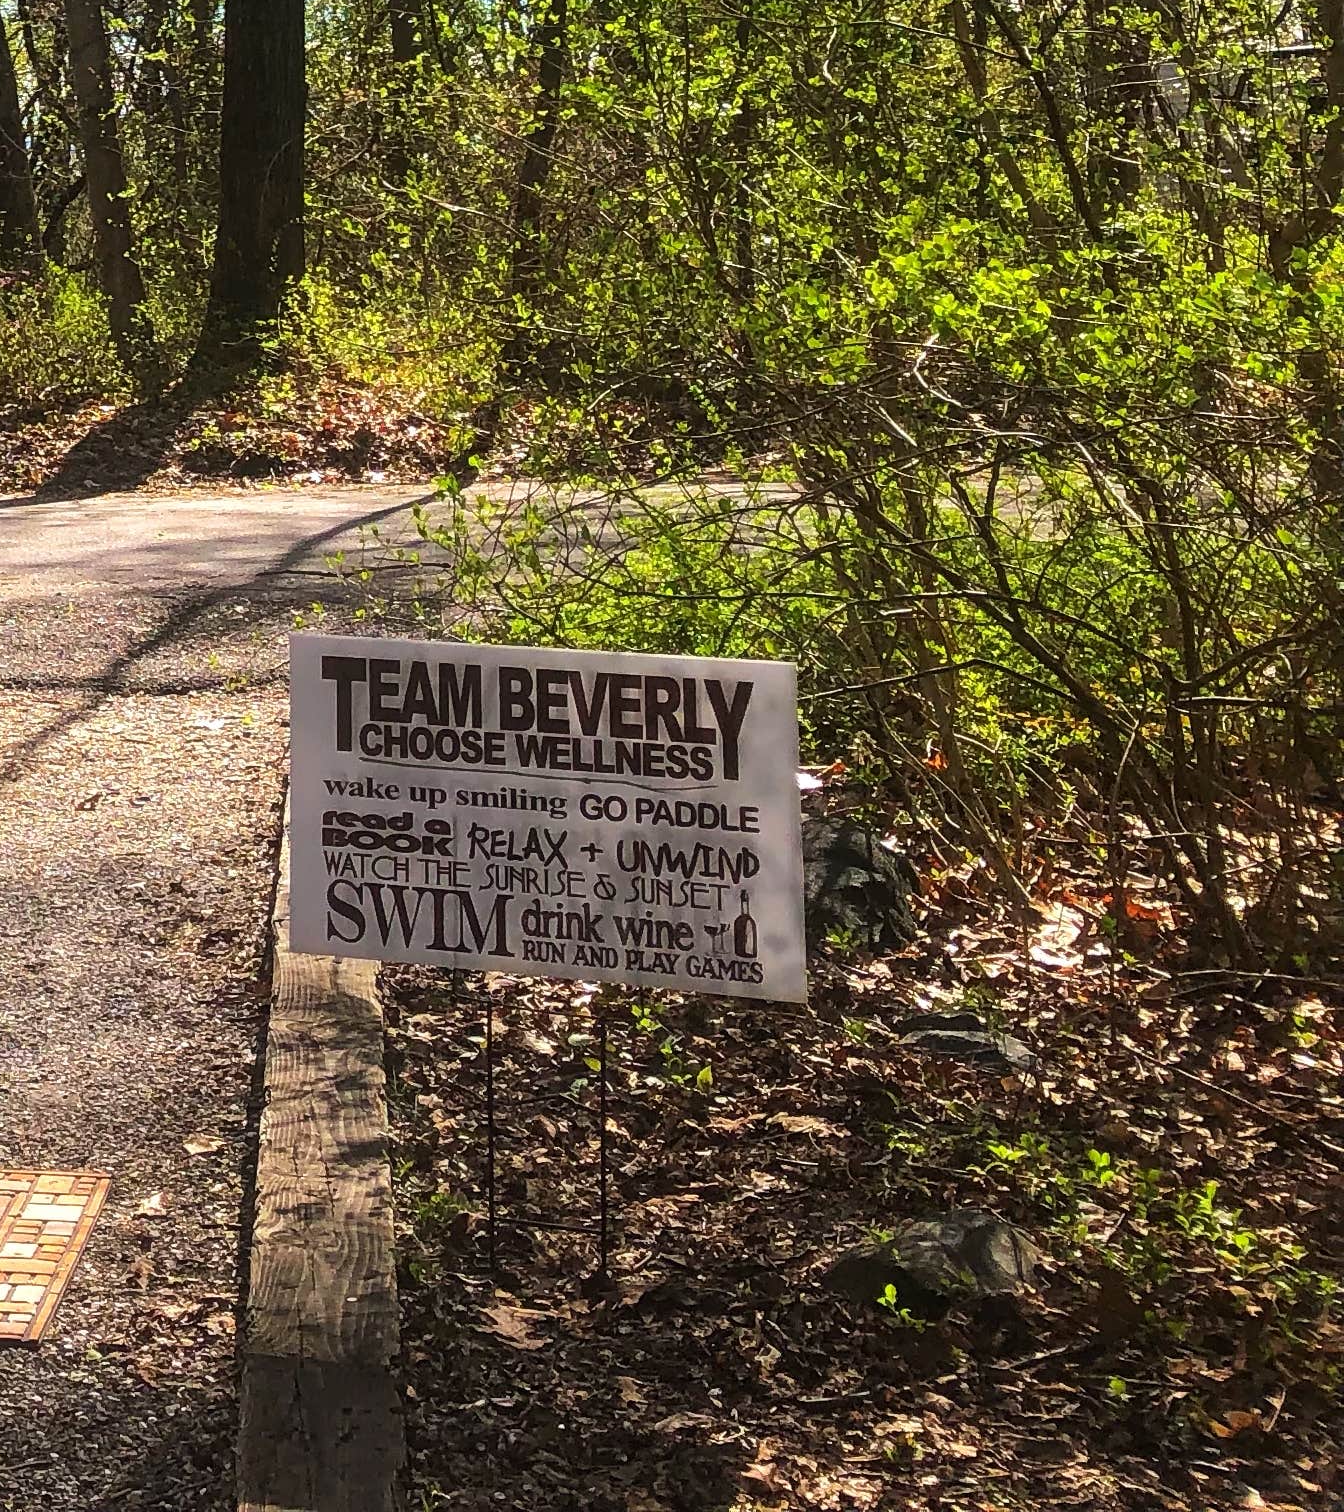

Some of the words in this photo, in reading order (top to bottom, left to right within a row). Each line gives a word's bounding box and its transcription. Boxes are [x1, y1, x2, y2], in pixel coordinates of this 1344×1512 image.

[322, 656, 482, 751] TEAM
[499, 666, 754, 781] BEVERLY
[359, 723, 506, 765] CHOOSE
[515, 734, 714, 781] WELLNESS
[322, 811, 413, 831] read
[424, 819, 452, 835] a
[323, 777, 400, 800] wake
[409, 786, 447, 809] up
[455, 787, 567, 819] smiling
[579, 793, 628, 821] GO
[635, 798, 761, 833] PADDLE
[322, 828, 454, 856] BOOK
[467, 822, 568, 869] RELAX
[580, 843, 603, 862] +
[616, 839, 760, 884] UNWIND
[323, 850, 409, 882] WATCH
[417, 859, 471, 887] THE
[479, 863, 586, 898] SUNRISE
[593, 873, 616, 900] &
[624, 876, 730, 911] SUNSET
[327, 879, 515, 957] SWIM
[521, 898, 605, 943] drink
[613, 911, 694, 951] wine
[522, 940, 565, 963] RUN
[572, 945, 618, 968] AND
[624, 949, 680, 974] PLAY
[686, 956, 764, 984] GAMES
